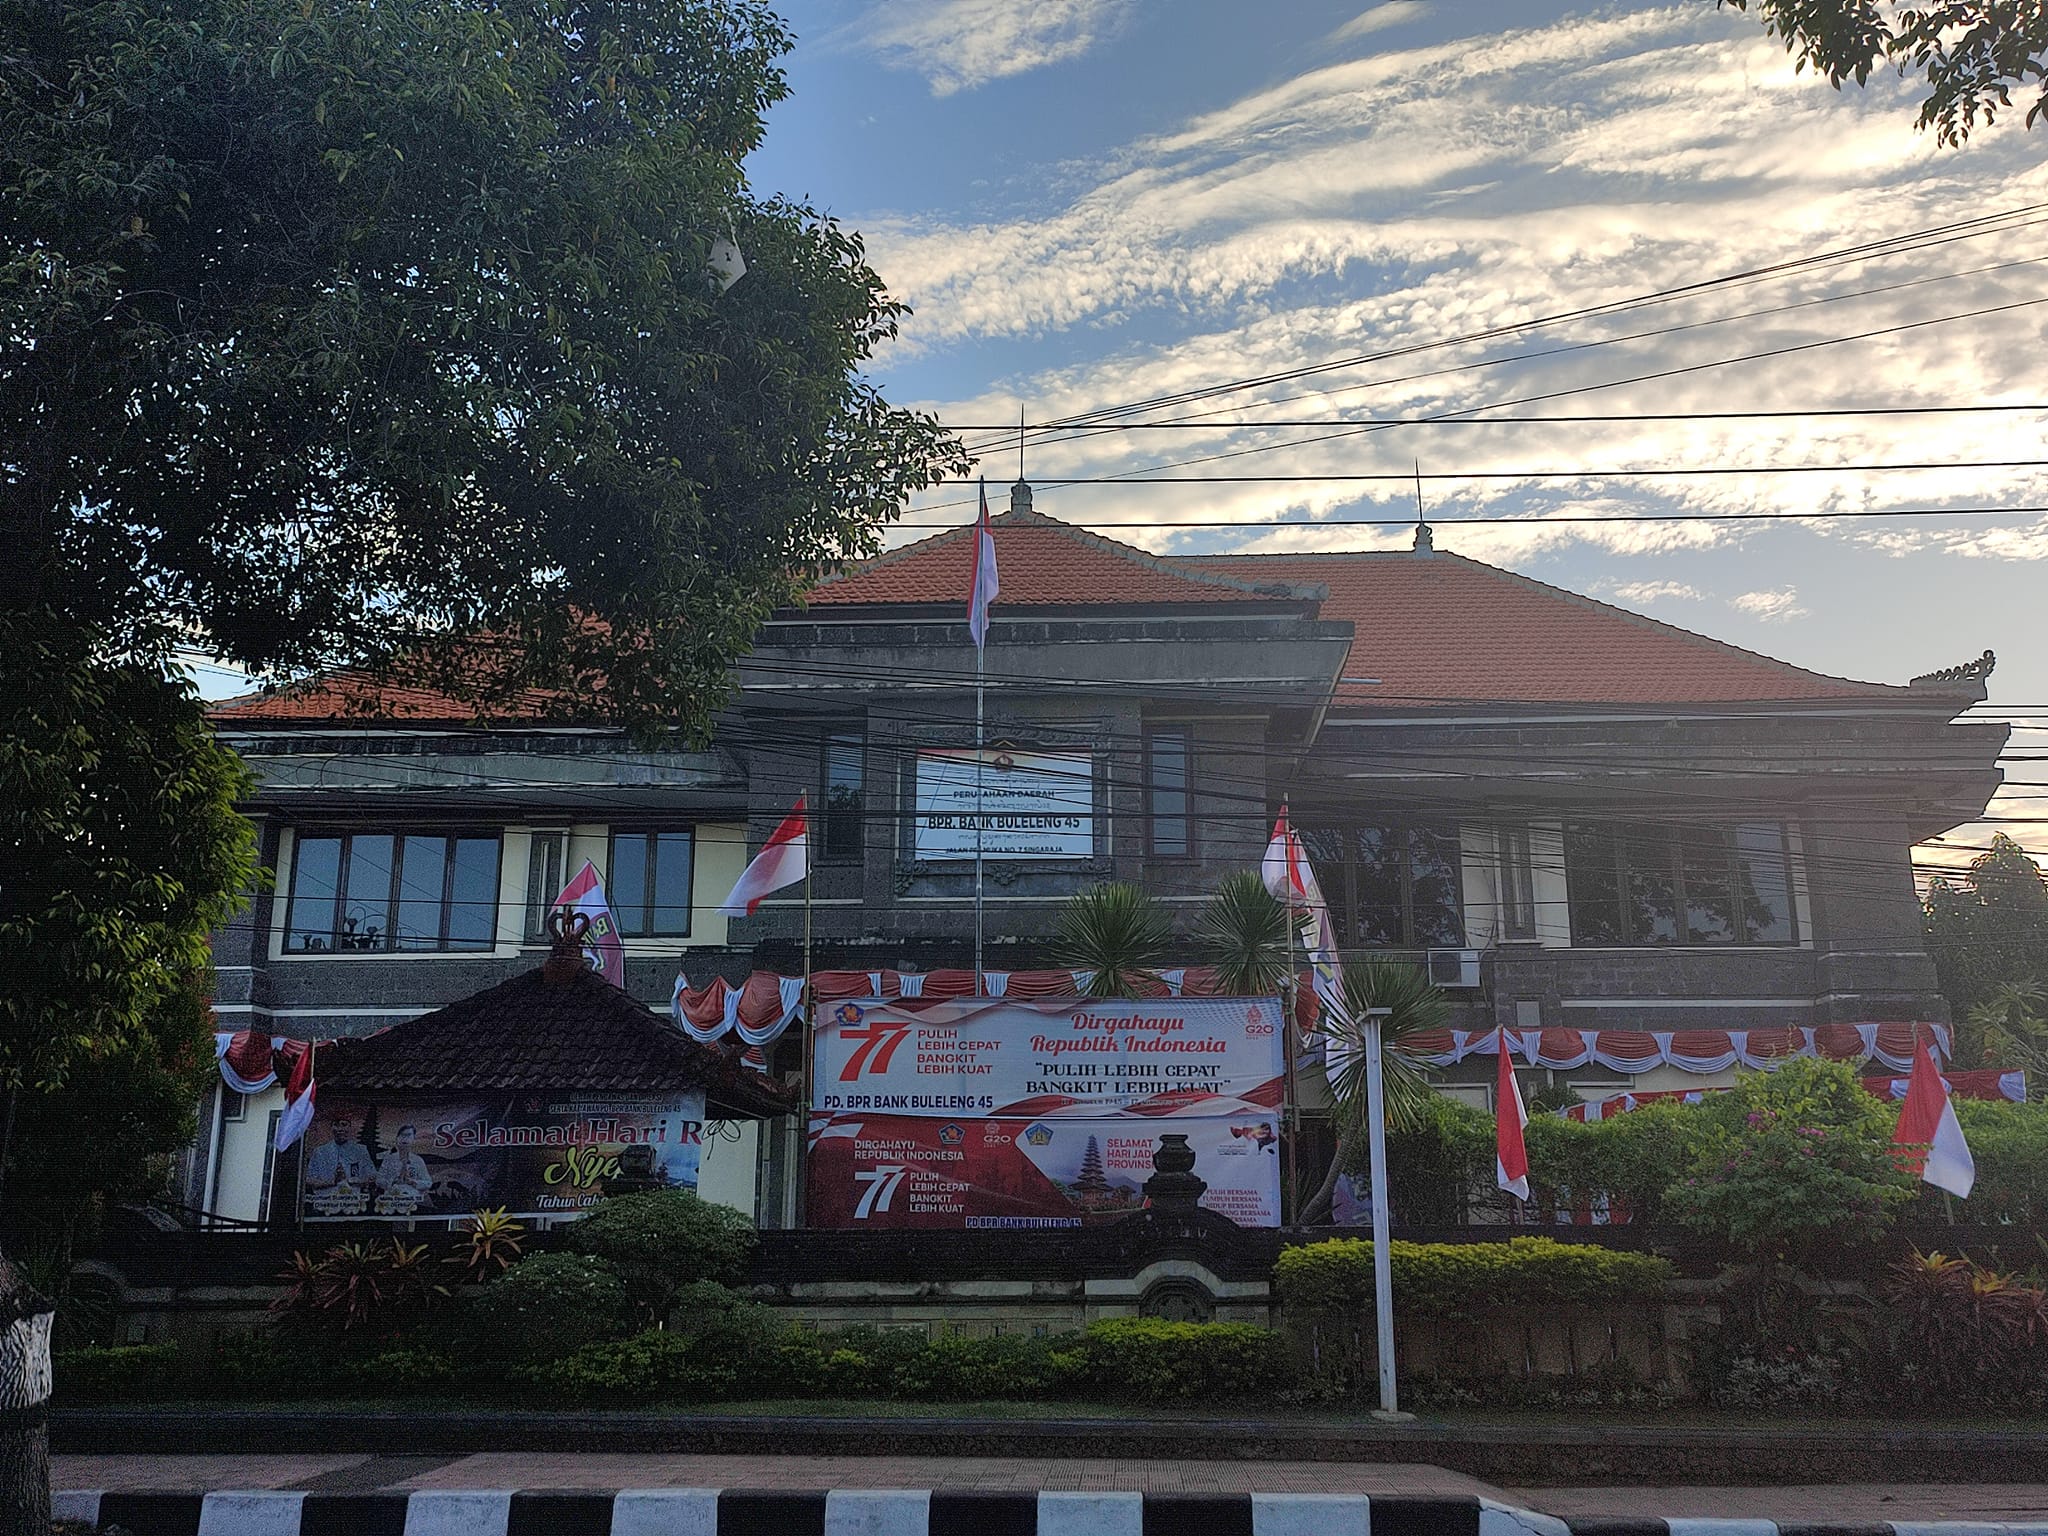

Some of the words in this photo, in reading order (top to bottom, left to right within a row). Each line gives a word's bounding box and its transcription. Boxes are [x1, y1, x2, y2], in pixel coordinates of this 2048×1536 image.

[953, 790, 1016, 798] PERUAHAAN
[928, 816, 956, 829] BPR.
[997, 816, 1062, 829] BULELENG
[1065, 816, 1080, 828] 45
[1071, 1012, 1184, 1034] Dirgahayu
[917, 1029, 958, 1039] PULIH
[1245, 1025, 1274, 1034] G20
[917, 1041, 955, 1050] LEBIH
[958, 1041, 1001, 1051] CEPAT
[1030, 1034, 1119, 1057] Republik
[1124, 1035, 1226, 1053] Indonesia
[839, 1022, 912, 1081] 77
[917, 1054, 977, 1063] BANGKIT
[916, 1065, 954, 1074] LEBIH
[957, 1065, 993, 1074] KUAT
[1104, 1064, 1158, 1077] LEBIH
[1165, 1064, 1221, 1077] CEPAT
[1026, 1080, 1108, 1094] BANGKIT
[1114, 1081, 1169, 1094] LEBIH
[824, 1095, 844, 1108] PD.
[847, 1095, 871, 1108] BPR
[874, 1095, 908, 1108] BANK
[912, 1095, 975, 1108] BULELENG
[978, 1095, 993, 1108] 45
[434, 1118, 580, 1149] Selamat
[585, 1117, 668, 1146] Hari
[983, 1135, 1011, 1144] G20
[1107, 1138, 1153, 1148] SELAMAT
[854, 1141, 915, 1150] DIRGAHAYU
[854, 1151, 905, 1160] REPUBLIK
[907, 1151, 964, 1161] INDONESIA
[1107, 1149, 1131, 1158] HARI
[854, 1165, 906, 1219] 77
[910, 1183, 937, 1191] LEBIH
[939, 1183, 970, 1192] CEPAT
[535, 1195, 575, 1209] Tahun
[910, 1194, 953, 1203] BANGKIT
[910, 1204, 937, 1212] LEBIH
[938, 1204, 964, 1212] KUAT
[980, 1217, 998, 1228] BPR
[999, 1217, 1024, 1228] BANK
